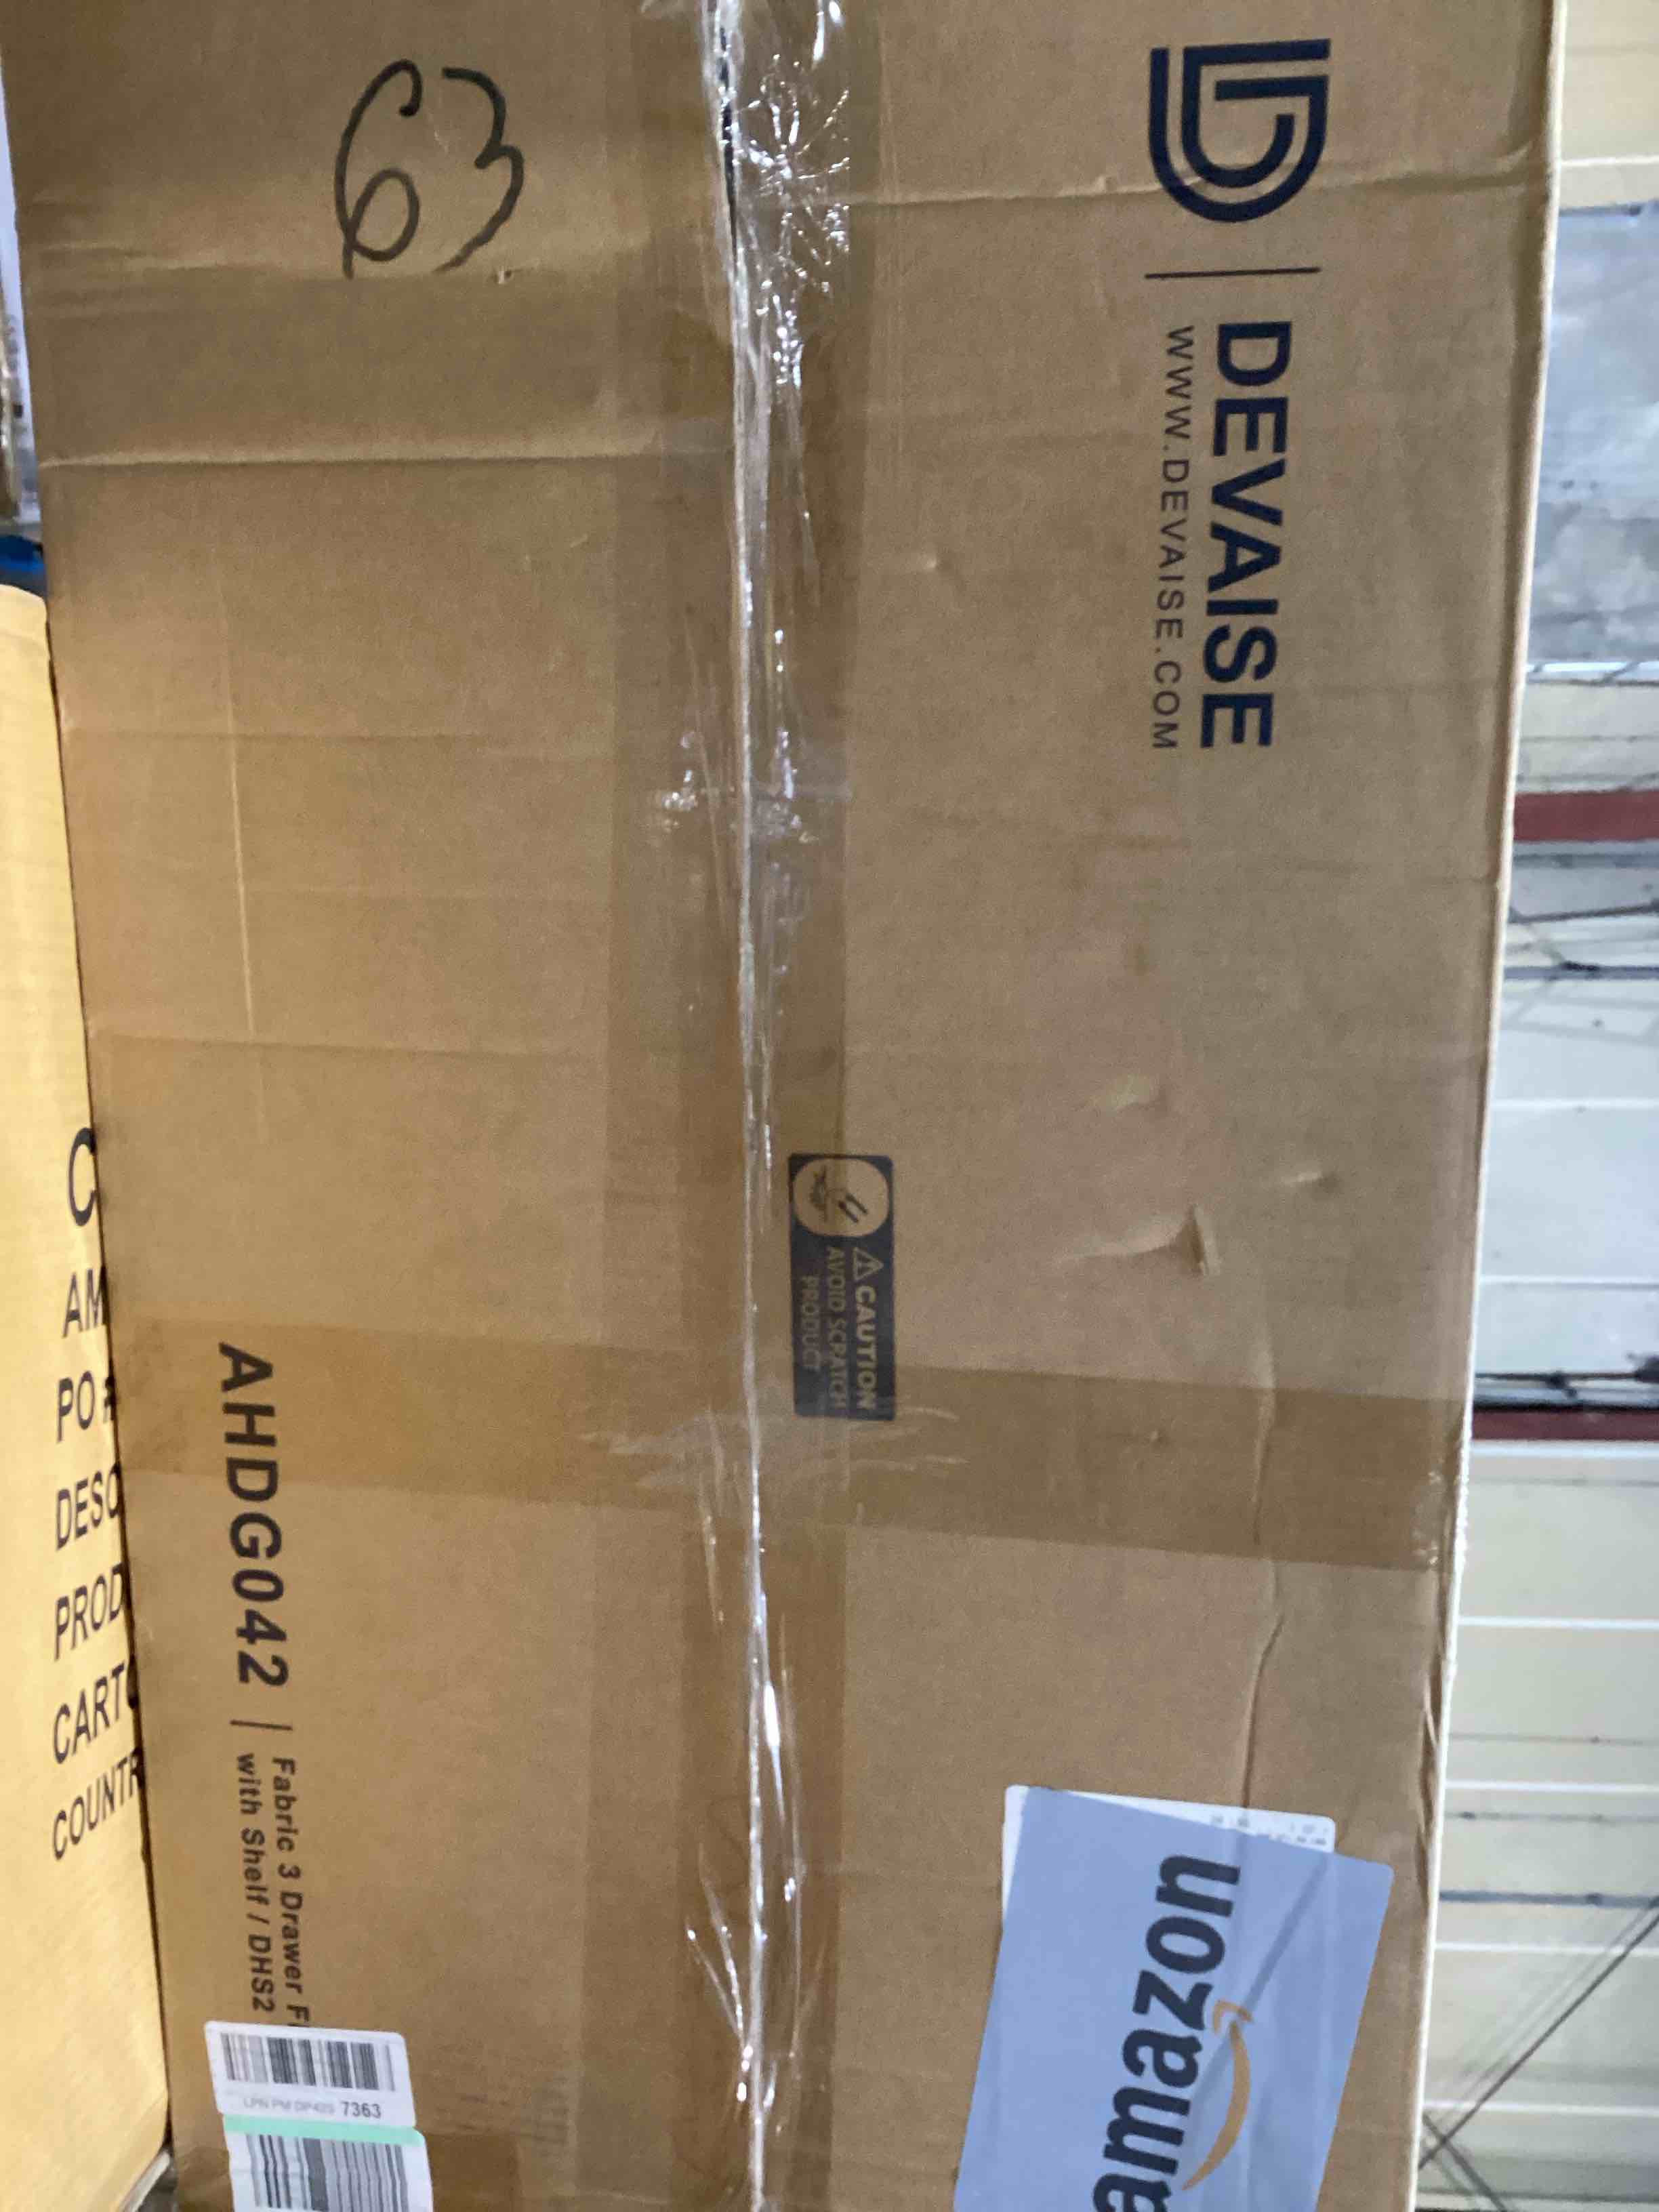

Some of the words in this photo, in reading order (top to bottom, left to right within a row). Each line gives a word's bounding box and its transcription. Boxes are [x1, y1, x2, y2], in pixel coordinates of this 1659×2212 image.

[334, 58, 524, 279] 63
[1153, 324, 1195, 750] WWW.DEVAISE.COM
[1200, 320, 1292, 748] DEVAISE
[801, 1275, 821, 1372] PRODUCT
[827, 1246, 846, 1313] AVOID
[827, 1318, 848, 1408] SCRATCH
[855, 1286, 877, 1410] CAUTION
[57, 1370, 95, 1443] PO
[218, 1341, 289, 1686] AHDG042
[237, 1753, 262, 1815] with
[272, 1757, 299, 1851] Fabric
[241, 1828, 270, 1905] Shelf
[278, 1864, 301, 1879] 3
[248, 1934, 274, 2012] DHS2
[280, 1890, 303, 1994] Drawer
[1093, 1855, 1241, 2212] amazon
[341, 2102, 382, 2118] 7363
